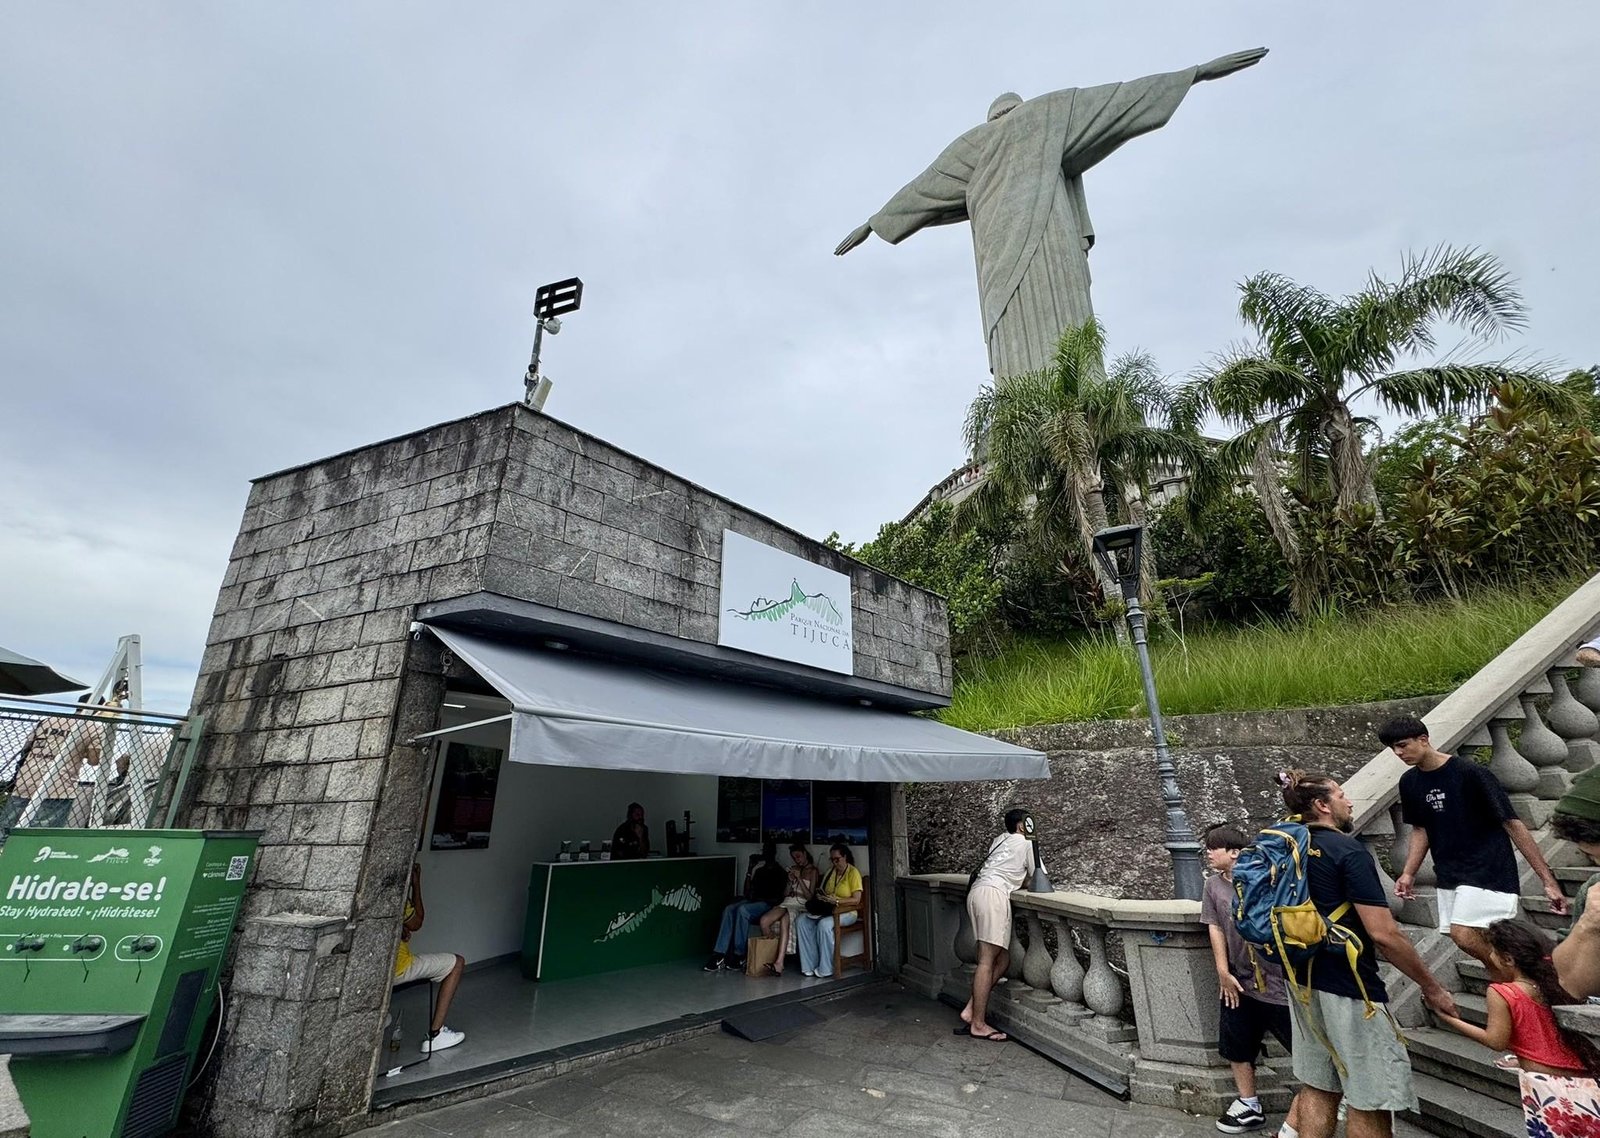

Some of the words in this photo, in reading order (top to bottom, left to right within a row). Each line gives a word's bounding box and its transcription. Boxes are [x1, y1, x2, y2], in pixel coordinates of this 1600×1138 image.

[790, 622, 850, 650] TIJUCA
[6, 874, 167, 901] Hidrate-se!
[0, 905, 25, 919] Stay
[25, 905, 85, 919] Hydrated!
[91, 906, 160, 920] ¡Hidrátese!
